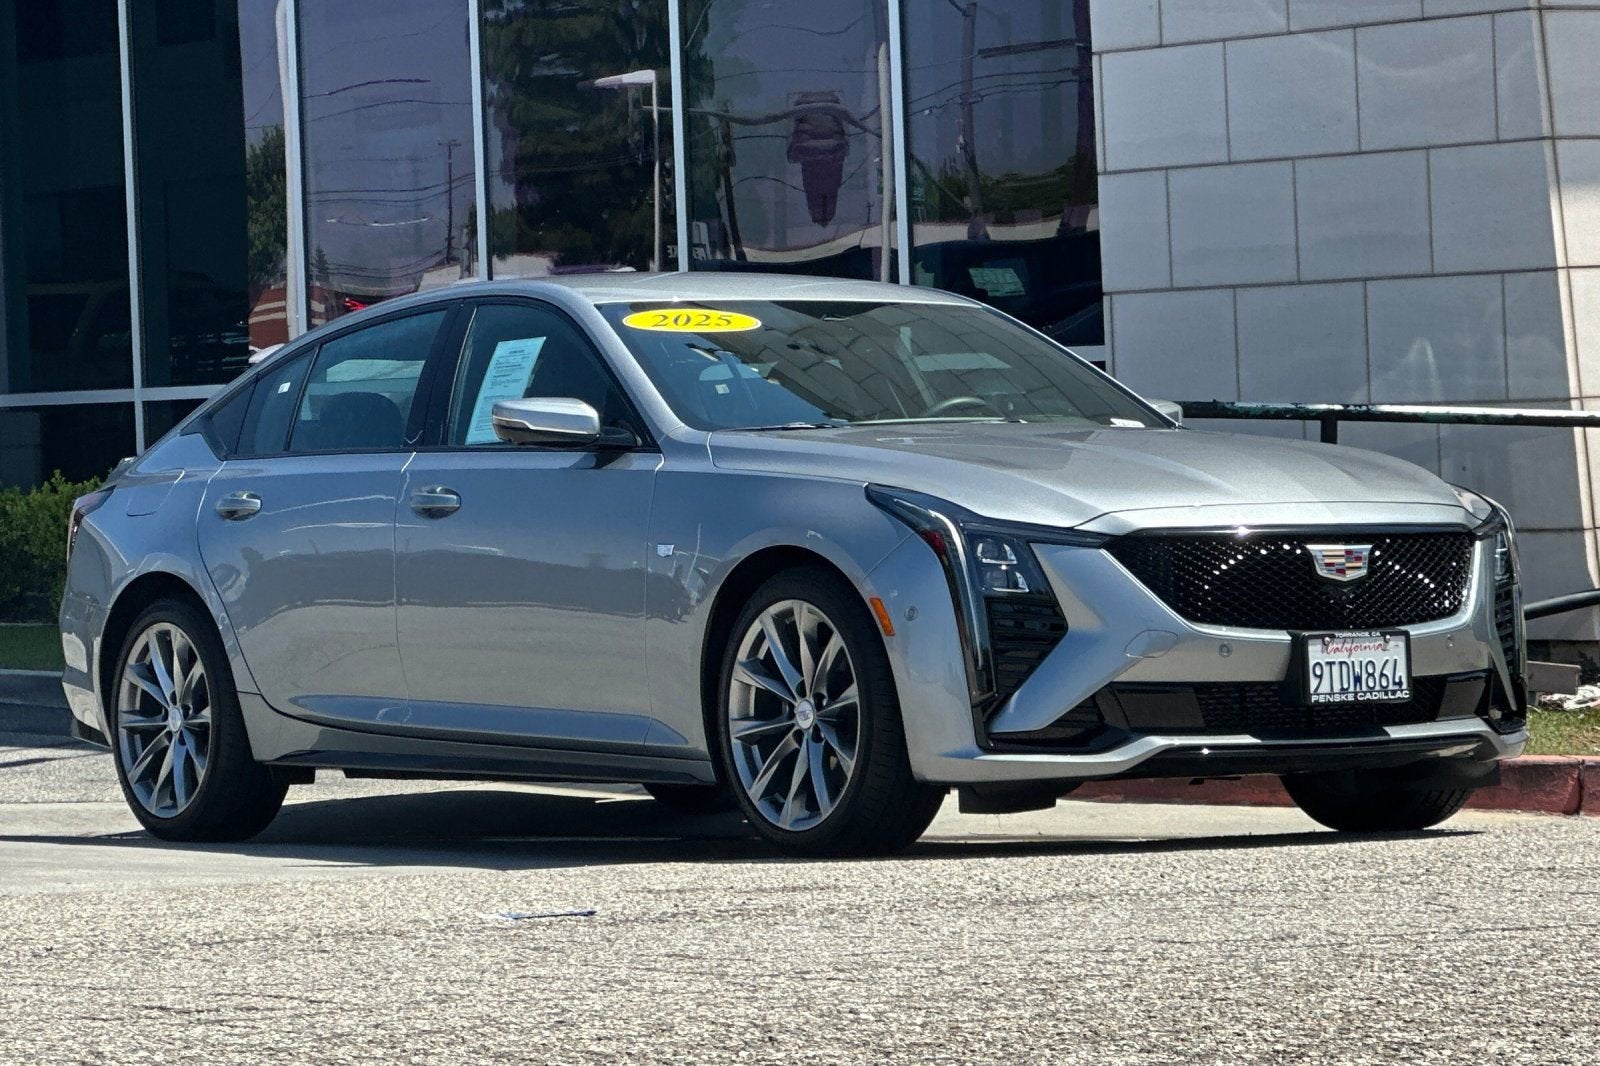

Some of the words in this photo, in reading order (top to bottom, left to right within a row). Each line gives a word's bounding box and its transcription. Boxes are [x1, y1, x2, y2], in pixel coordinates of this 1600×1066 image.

[652, 313, 733, 327] 2025
[1326, 639, 1384, 658] California
[1312, 658, 1404, 693] 9TDW864
[1311, 693, 1355, 703] PENSKE
[1357, 690, 1410, 701] CADILLAC
